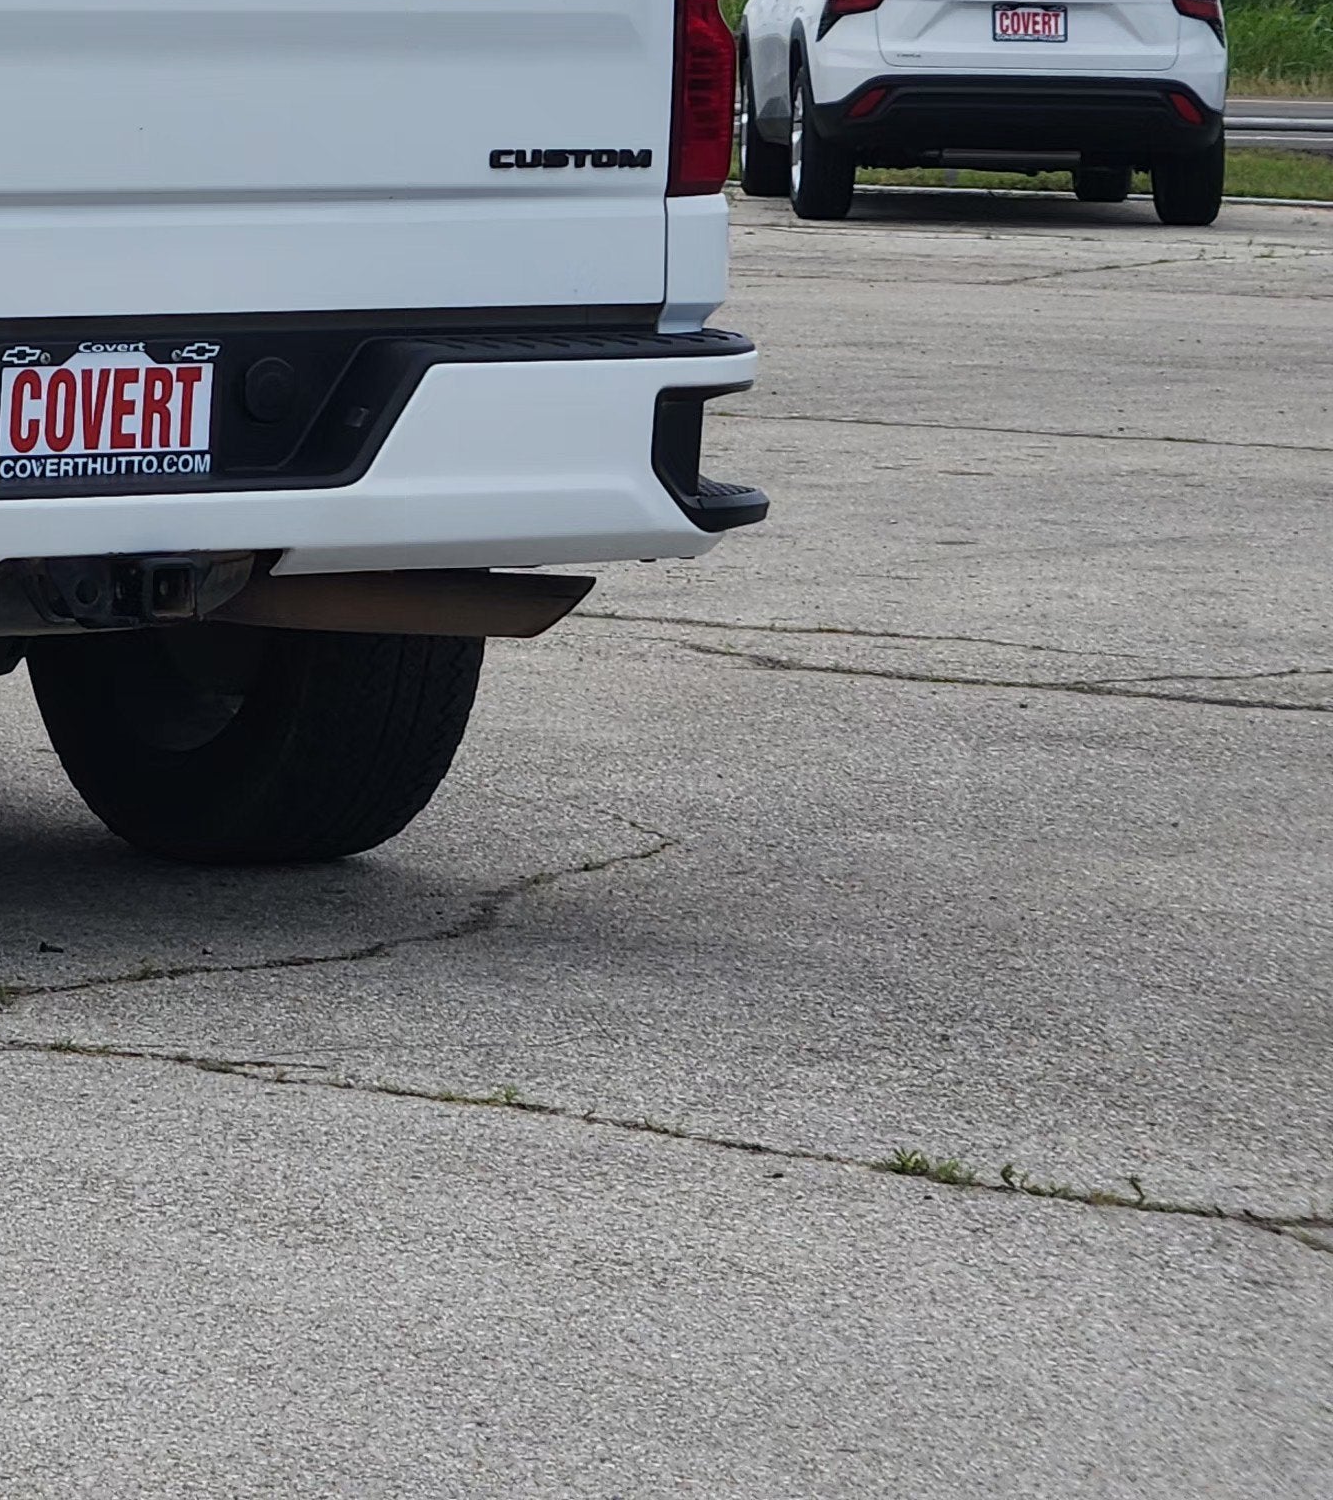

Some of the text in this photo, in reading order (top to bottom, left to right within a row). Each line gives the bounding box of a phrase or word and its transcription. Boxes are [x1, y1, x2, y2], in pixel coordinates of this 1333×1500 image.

[999, 11, 1061, 35] COVERT
[489, 148, 653, 169] CUSTOM
[78, 342, 147, 353] Covert
[9, 366, 203, 453] COVERT
[0, 454, 211, 478] COVERTHUTTO.COM
